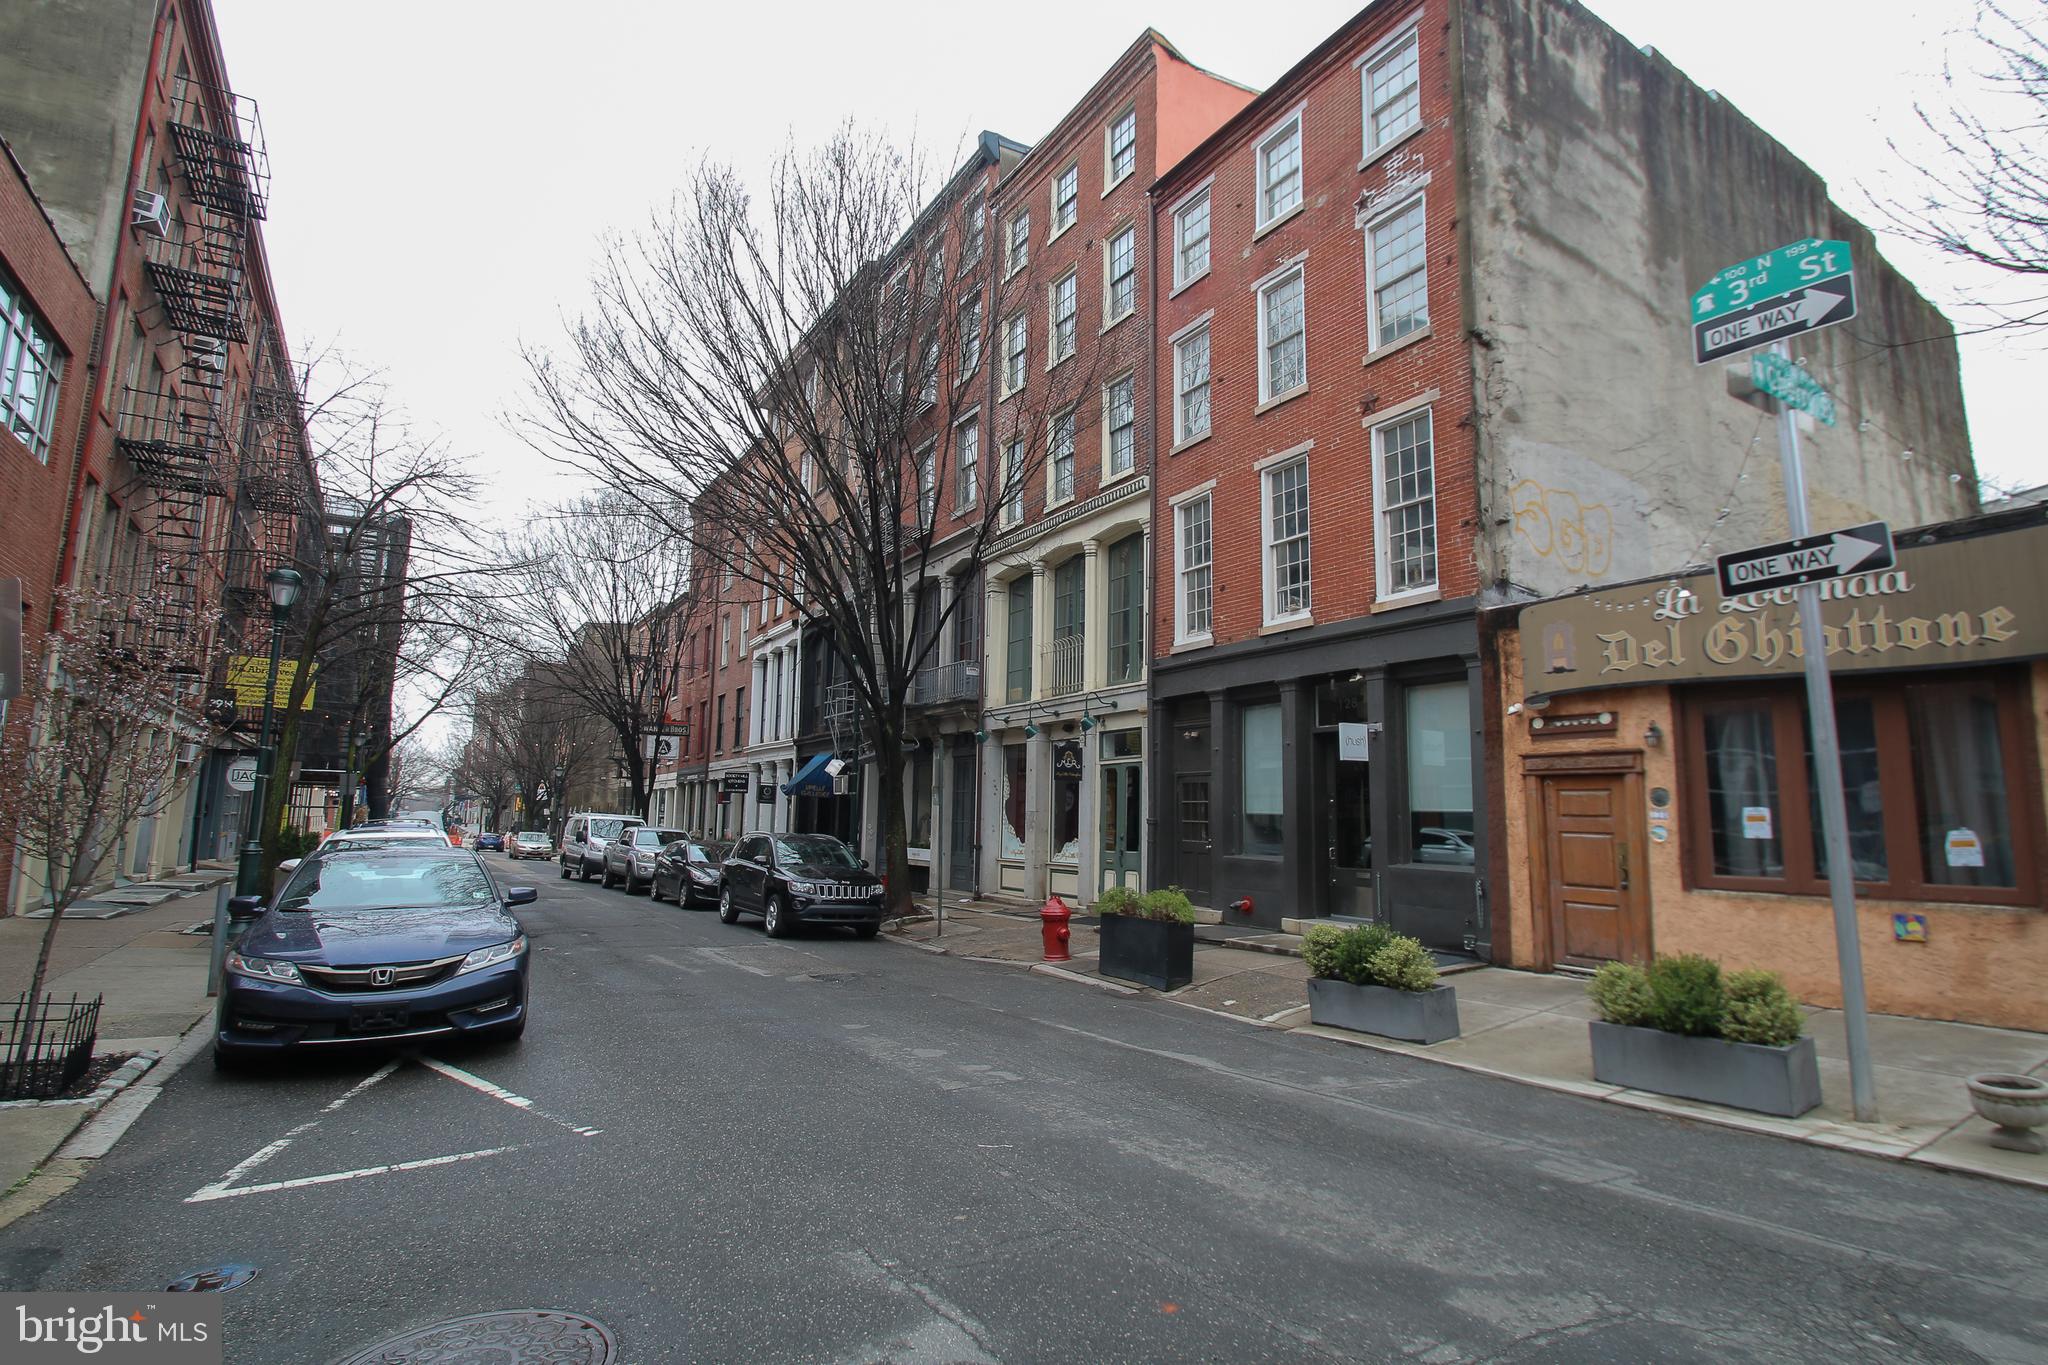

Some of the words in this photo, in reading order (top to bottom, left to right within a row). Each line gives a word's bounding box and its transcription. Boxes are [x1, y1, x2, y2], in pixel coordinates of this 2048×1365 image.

[1724, 266, 1747, 281] 100
[1756, 255, 1773, 271] N
[1785, 243, 1809, 259] 199
[1727, 271, 1769, 306] 3rd
[1799, 251, 1838, 281] St
[1710, 320, 1751, 346] ONE
[1757, 303, 1802, 332] WAY
[1734, 558, 1780, 583] ONE
[1786, 546, 1836, 572] WAY
[1653, 585, 1703, 621] La
[1718, 570, 1916, 614] Locnda
[1596, 620, 1687, 675] Del
[1704, 605, 2019, 668] Ghiottone
